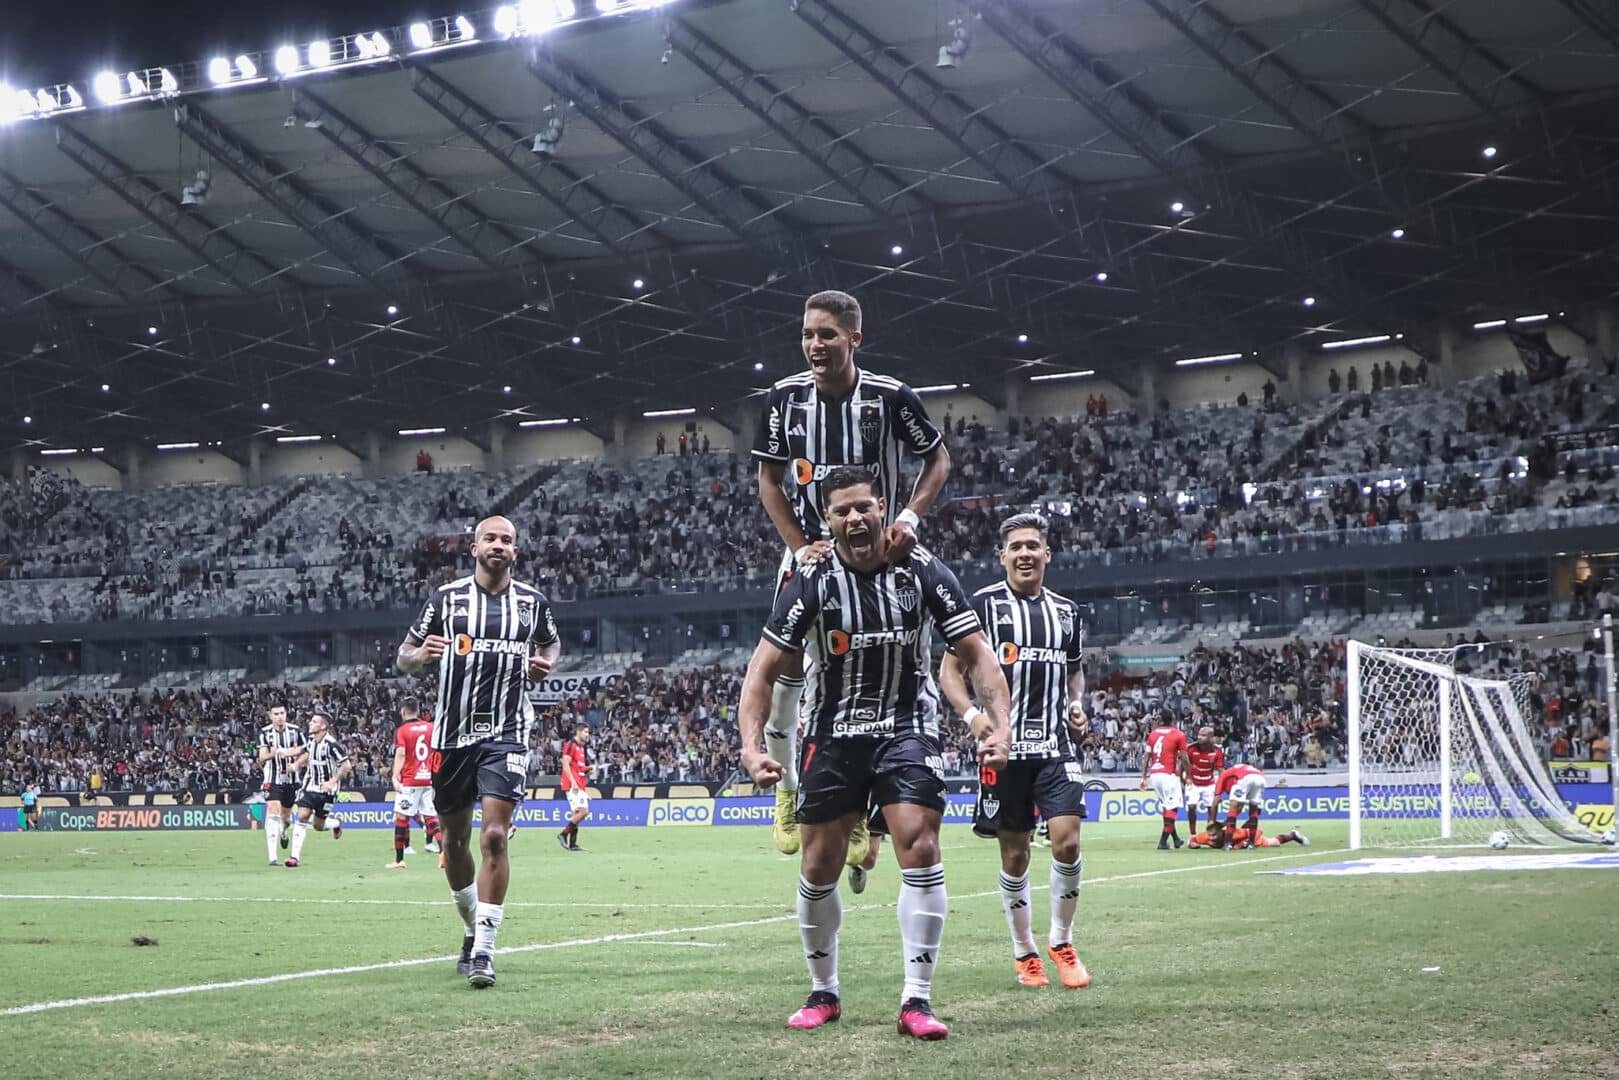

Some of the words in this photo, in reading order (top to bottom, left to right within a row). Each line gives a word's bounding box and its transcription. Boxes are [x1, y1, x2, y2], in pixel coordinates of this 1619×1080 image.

[472, 638, 525, 654] BETANO
[851, 629, 916, 650] BETANO
[1018, 647, 1067, 665] BETANO
[834, 720, 893, 734] GERDAU
[415, 733, 429, 761] 6
[1010, 741, 1057, 752] GERDAU
[1153, 735, 1164, 757] 4
[804, 744, 817, 772] 7
[653, 801, 709, 824] placo
[1307, 797, 1349, 812] LEVE
[96, 810, 161, 828] BETANO
[163, 811, 181, 827] do
[184, 810, 239, 826] BRASIL
